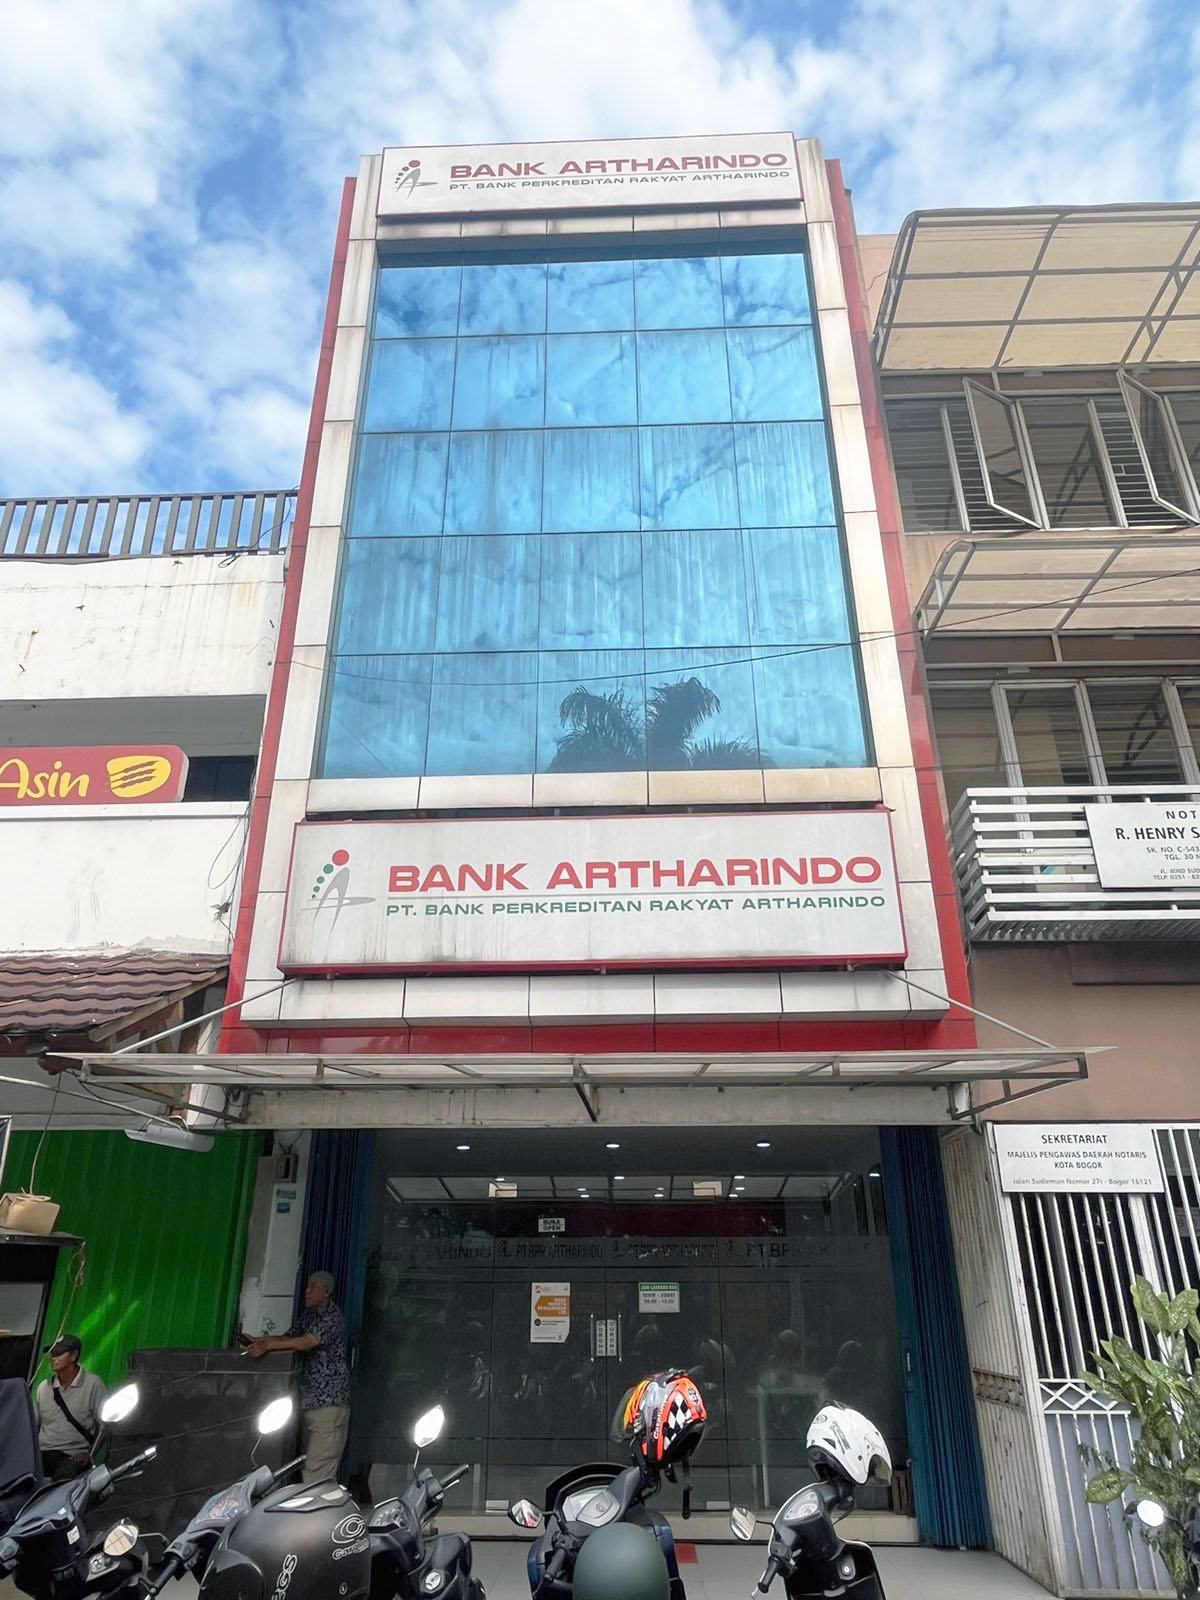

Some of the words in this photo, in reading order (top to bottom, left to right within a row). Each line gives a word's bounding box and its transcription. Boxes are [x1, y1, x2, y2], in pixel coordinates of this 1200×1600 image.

[450, 162, 546, 179] BANK
[559, 153, 788, 175] ARTHARINDO
[449, 183, 471, 191] PT.
[476, 181, 517, 189] BANK
[522, 177, 625, 188] PERKREDITAN
[629, 175, 687, 184] RAKYAT
[692, 171, 790, 182] ARTHARINDO
[0, 758, 90, 799] Asin
[1166, 810, 1197, 820] NOT
[1115, 827, 1130, 840] R.
[1134, 827, 1186, 840] HENRY
[388, 863, 530, 893] BANK
[545, 856, 882, 890] ARTHARINDO
[386, 904, 417, 917] PT.
[424, 903, 485, 916] BANK
[492, 901, 642, 915] PERKREDITAN
[649, 899, 734, 912] RAKYAT
[741, 895, 886, 910] ARTHARINDO
[1041, 1134, 1108, 1144] SEKRETARIAT
[1007, 1151, 1038, 1159] MAJELIS
[1039, 1151, 1081, 1159] PENGAWAS
[1082, 1151, 1113, 1159] DAERAH
[1115, 1151, 1147, 1159] NOTARIS
[1108, 1178, 1129, 1186] Bogor
